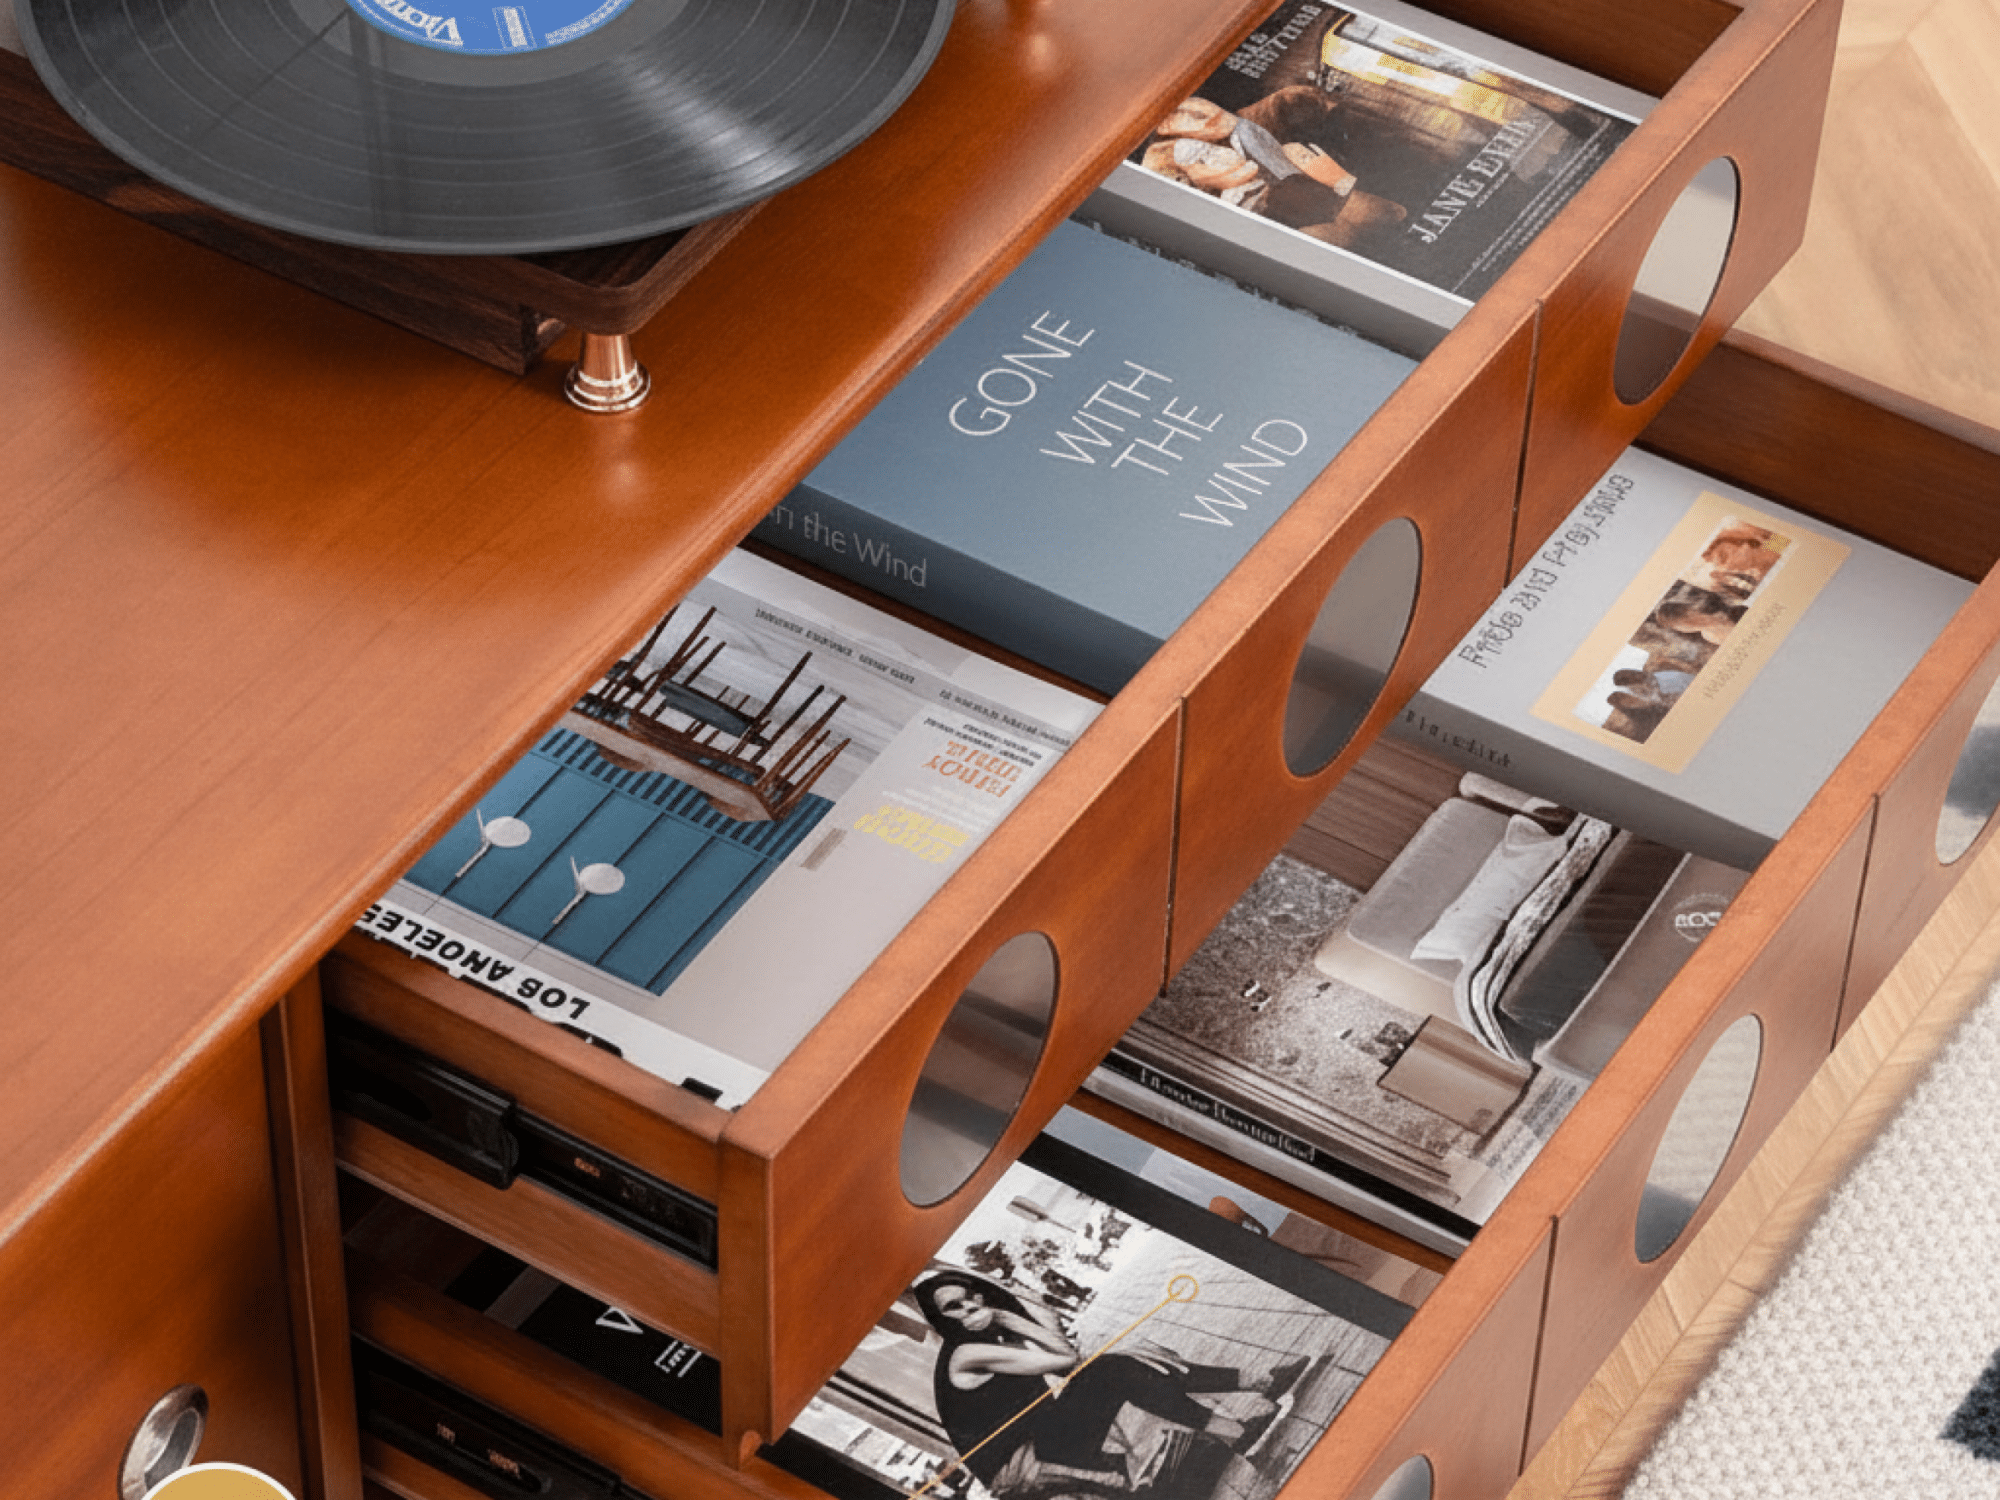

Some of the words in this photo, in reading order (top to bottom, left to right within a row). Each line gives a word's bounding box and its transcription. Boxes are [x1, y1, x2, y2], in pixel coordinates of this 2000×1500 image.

[947, 309, 1095, 437] GONE
[1039, 360, 1174, 467] WITH
[1111, 396, 1224, 476] THE
[1178, 418, 1309, 528] WIND
[853, 532, 927, 588] Wind
